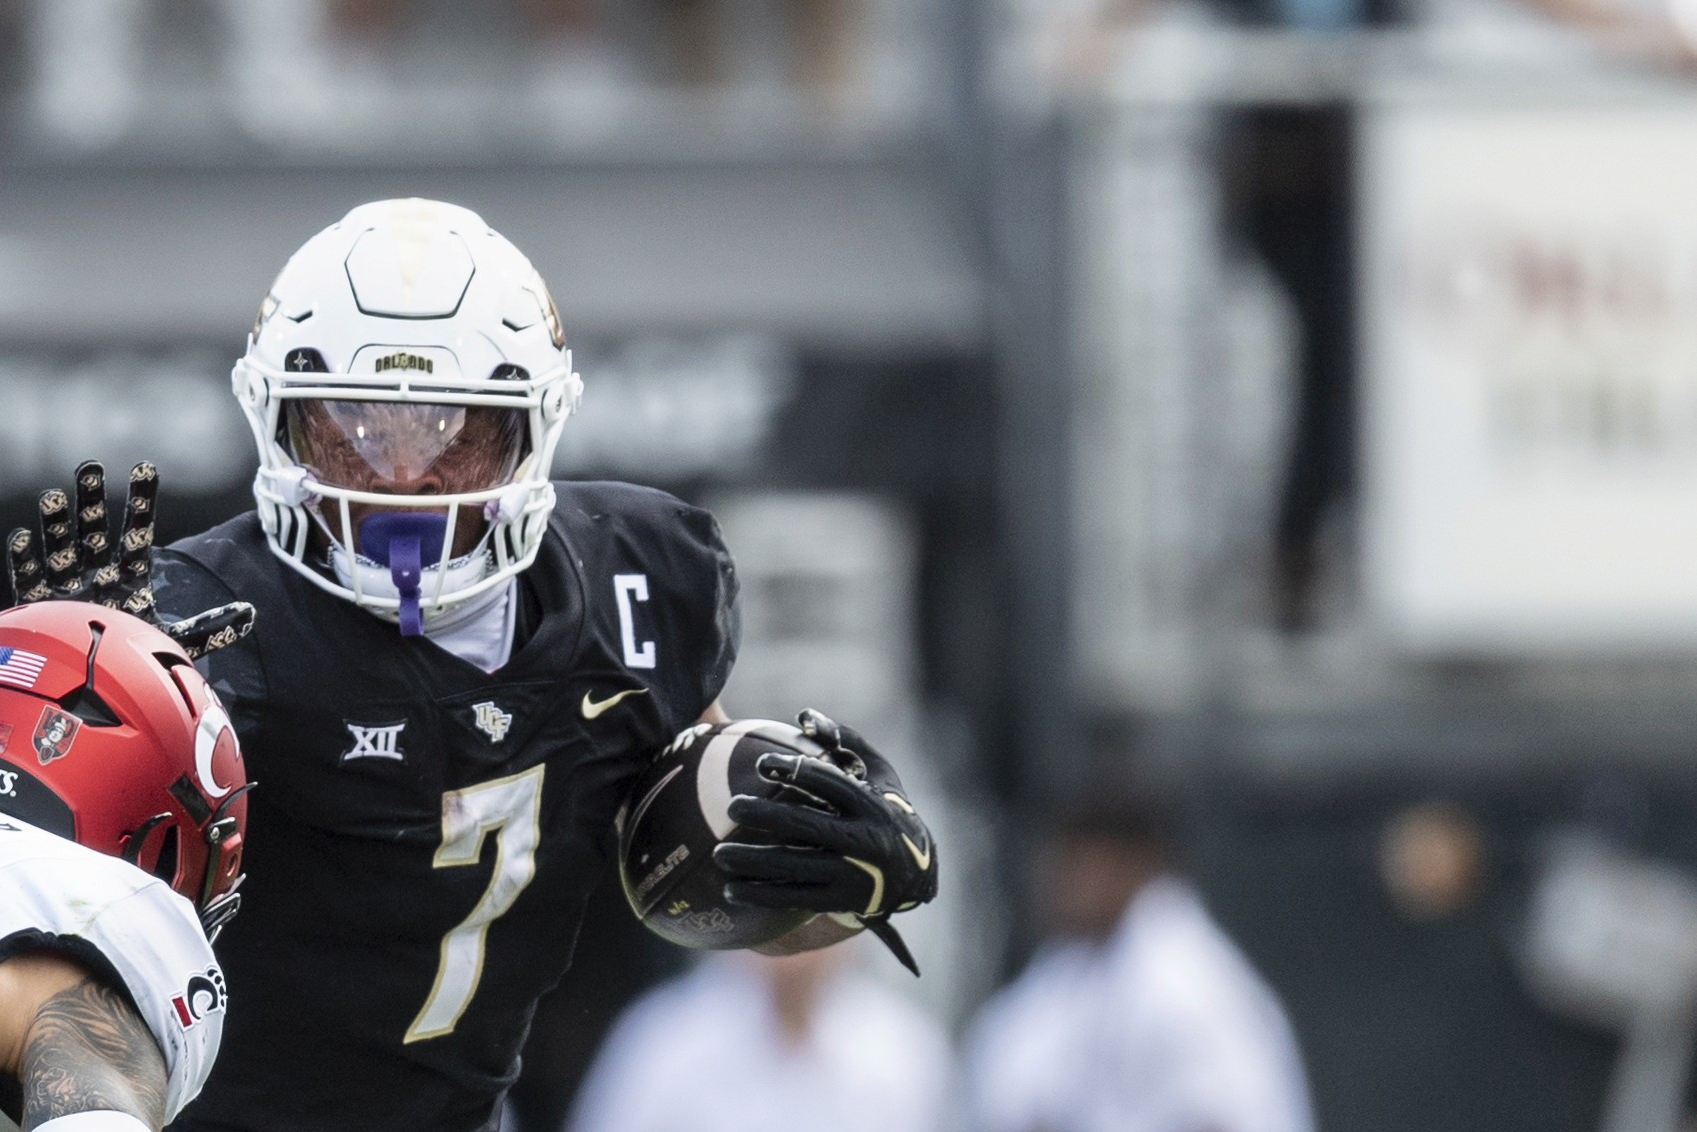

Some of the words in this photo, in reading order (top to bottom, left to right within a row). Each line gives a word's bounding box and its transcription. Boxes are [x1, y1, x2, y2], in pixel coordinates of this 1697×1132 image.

[614, 574, 656, 669] C
[343, 722, 407, 761] XII
[472, 701, 513, 743] UCF
[403, 763, 545, 1044] 7
